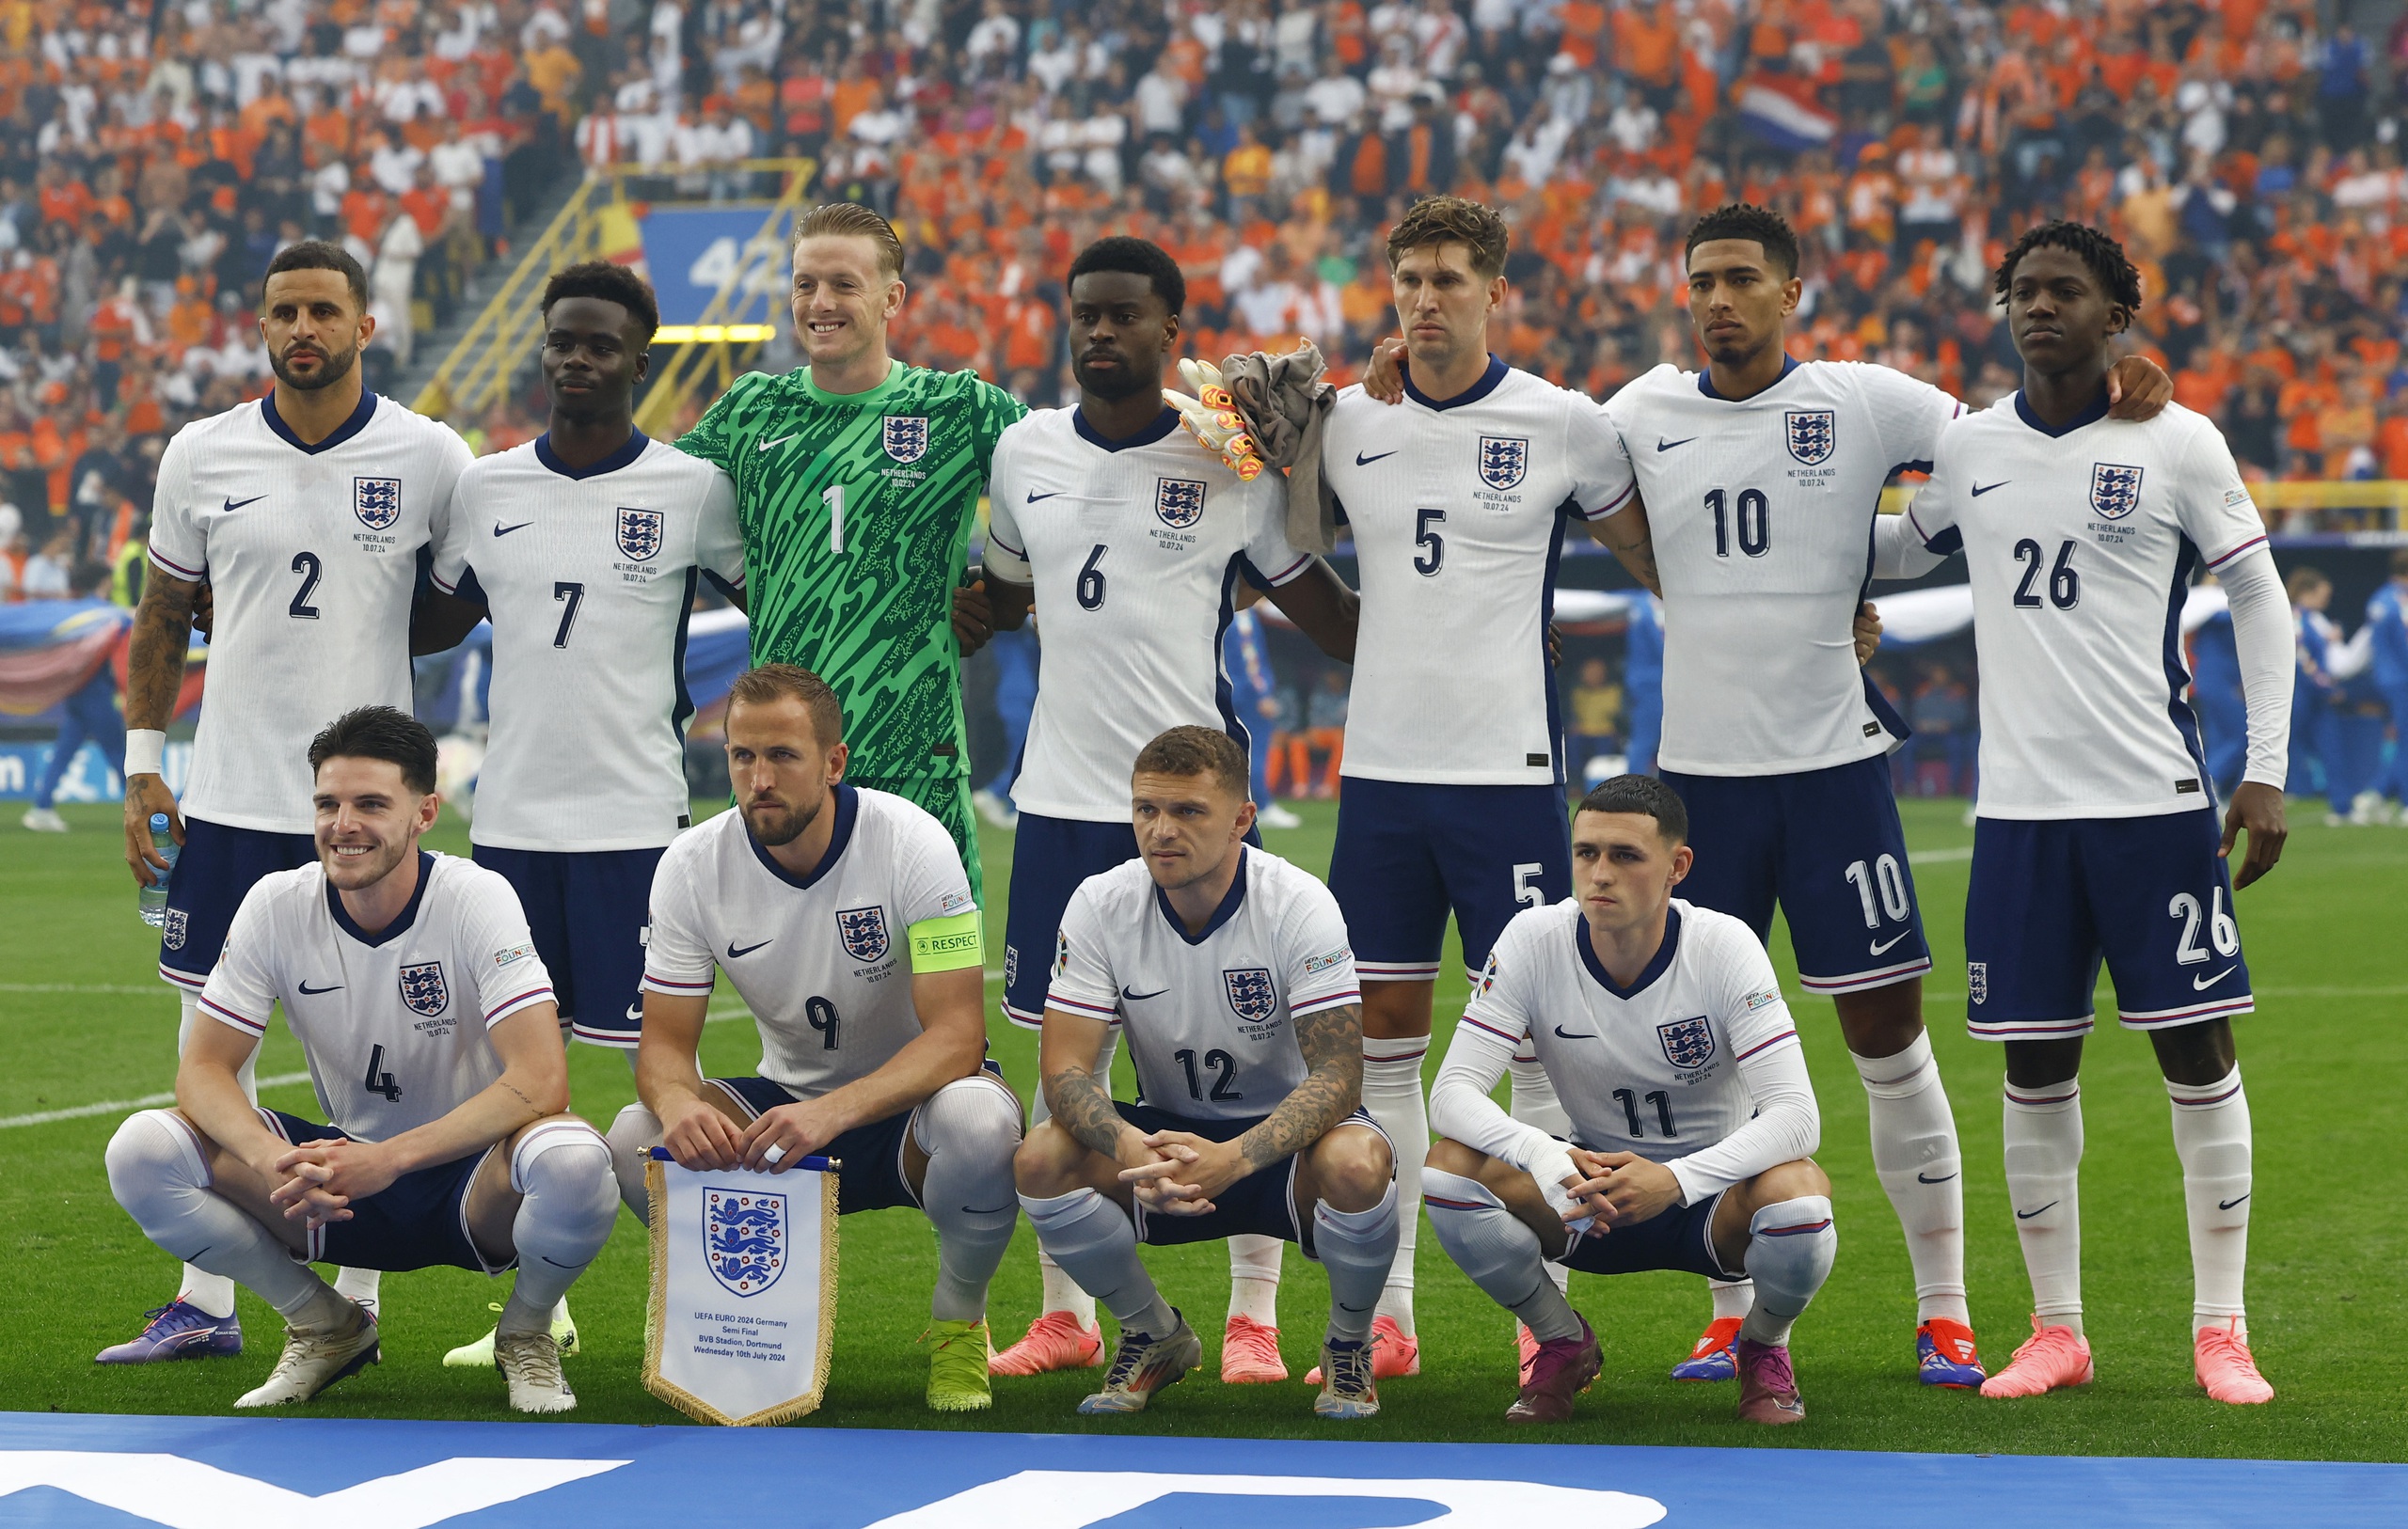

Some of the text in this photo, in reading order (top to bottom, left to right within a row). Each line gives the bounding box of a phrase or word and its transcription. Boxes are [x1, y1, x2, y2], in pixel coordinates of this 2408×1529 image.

[881, 468, 927, 480] NETHERLANDS
[1787, 468, 1835, 478] NETHERLANDS
[892, 479, 915, 488] 10.07.24
[1798, 479, 1825, 487] 10.07.24
[1473, 491, 1522, 503] NETHERLANDS
[1483, 501, 1509, 512] 10.07.24
[823, 485, 845, 554] 1
[1704, 488, 1770, 558] 10
[1149, 528, 1196, 544] NETHERLANDS
[2087, 523, 2135, 535] NETHERLANDS
[353, 533, 395, 544] NETHERLANDS
[1159, 540, 1184, 551] 10.07.24
[1414, 509, 1446, 577] 5
[2098, 534, 2124, 544] 10.07.24
[363, 544, 386, 553] 10.07.24
[613, 562, 657, 575] NETHERLANDS
[2013, 538, 2080, 610] 26
[623, 573, 646, 583] 10.07.24
[1076, 544, 1109, 611] 6
[290, 551, 323, 620] 2
[553, 581, 584, 649] 7
[1513, 862, 1545, 906] 5
[1845, 853, 1910, 929] 10
[2169, 886, 2239, 966] 26
[932, 935, 977, 951] RESPECT
[853, 958, 897, 978] NETHERLANDS
[866, 970, 892, 984] 10.07.24
[414, 1018, 457, 1031] NETHERLANDS
[805, 996, 840, 1050] 9
[1237, 1019, 1282, 1033] NETHERLANDS
[1250, 1031, 1275, 1042] 10.07.24
[365, 1044, 403, 1102] 4
[1174, 1048, 1243, 1102] 12
[1674, 1061, 1720, 1081] NETHERLANDS
[1687, 1073, 1712, 1086] 10.07.24
[1612, 1088, 1677, 1138] 11
[694, 1312, 713, 1321] UEFA
[715, 1314, 735, 1323] EURO
[755, 1317, 787, 1329] Germany
[722, 1326, 758, 1336] Semi Final
[716, 1337, 744, 1347] Stadion,
[746, 1340, 782, 1349] Dortmund
[693, 1346, 785, 1362] Wednesday 10th July 2024
